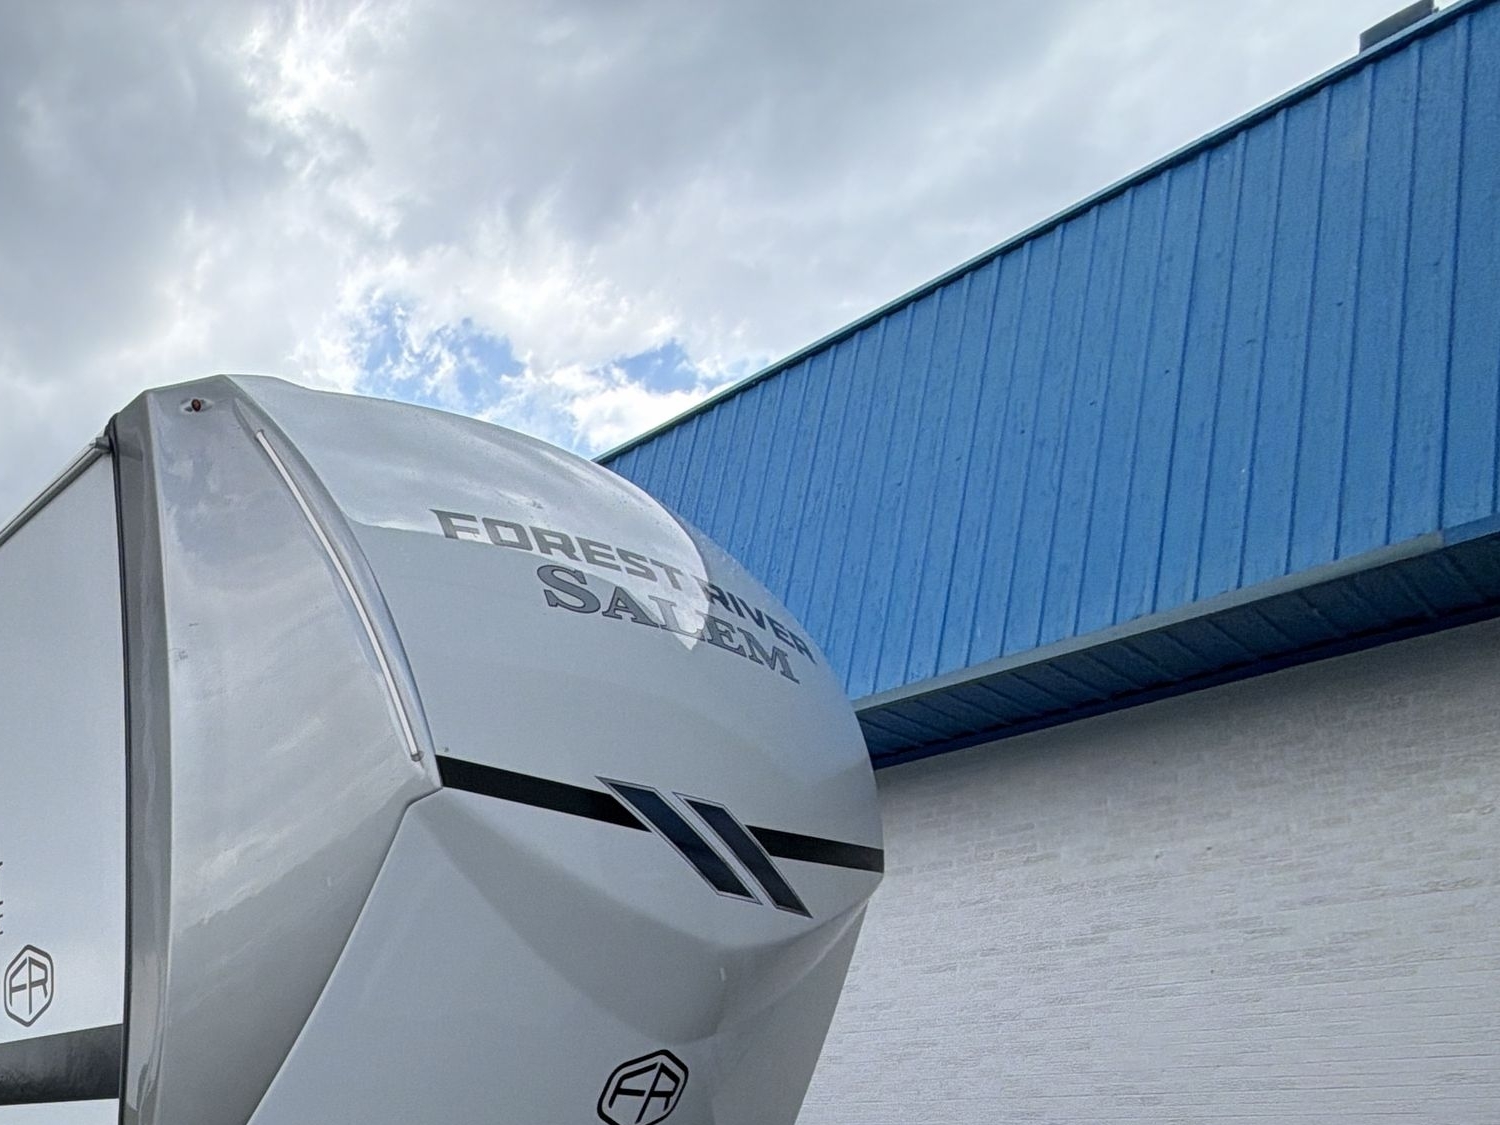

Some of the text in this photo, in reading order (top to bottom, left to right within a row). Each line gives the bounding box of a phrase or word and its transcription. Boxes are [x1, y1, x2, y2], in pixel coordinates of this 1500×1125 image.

[429, 508, 817, 665] FOREST RIVER
[536, 563, 801, 685] SALEM
